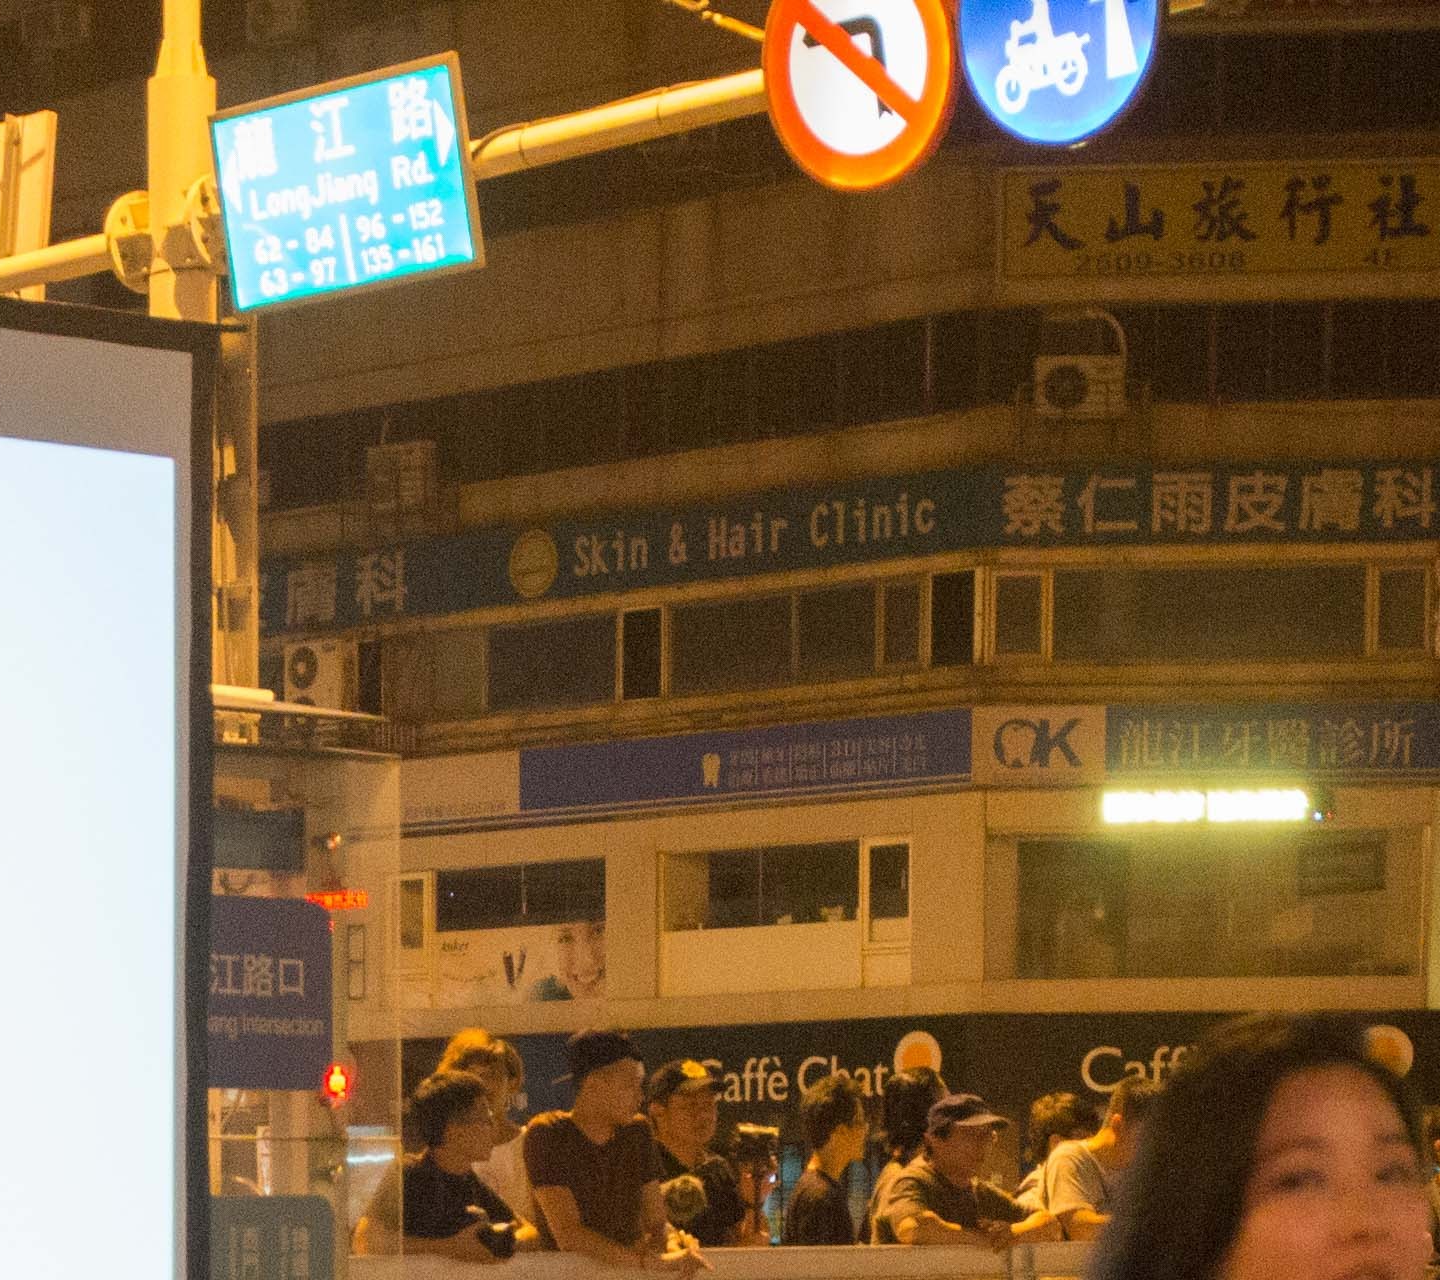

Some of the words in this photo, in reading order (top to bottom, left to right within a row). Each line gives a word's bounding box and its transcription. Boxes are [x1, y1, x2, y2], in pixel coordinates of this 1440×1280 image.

[390, 151, 435, 189] Rd.
[1023, 174, 1431, 252] 天山旅行社
[575, 532, 649, 578] Skin
[669, 526, 688, 566] &
[708, 513, 784, 562] Hair
[811, 495, 936, 548] Clinic
[1002, 467, 1436, 535] 蔡仁雨皮膚科
[261, 550, 407, 628] 膚科
[994, 718, 1083, 770] OK
